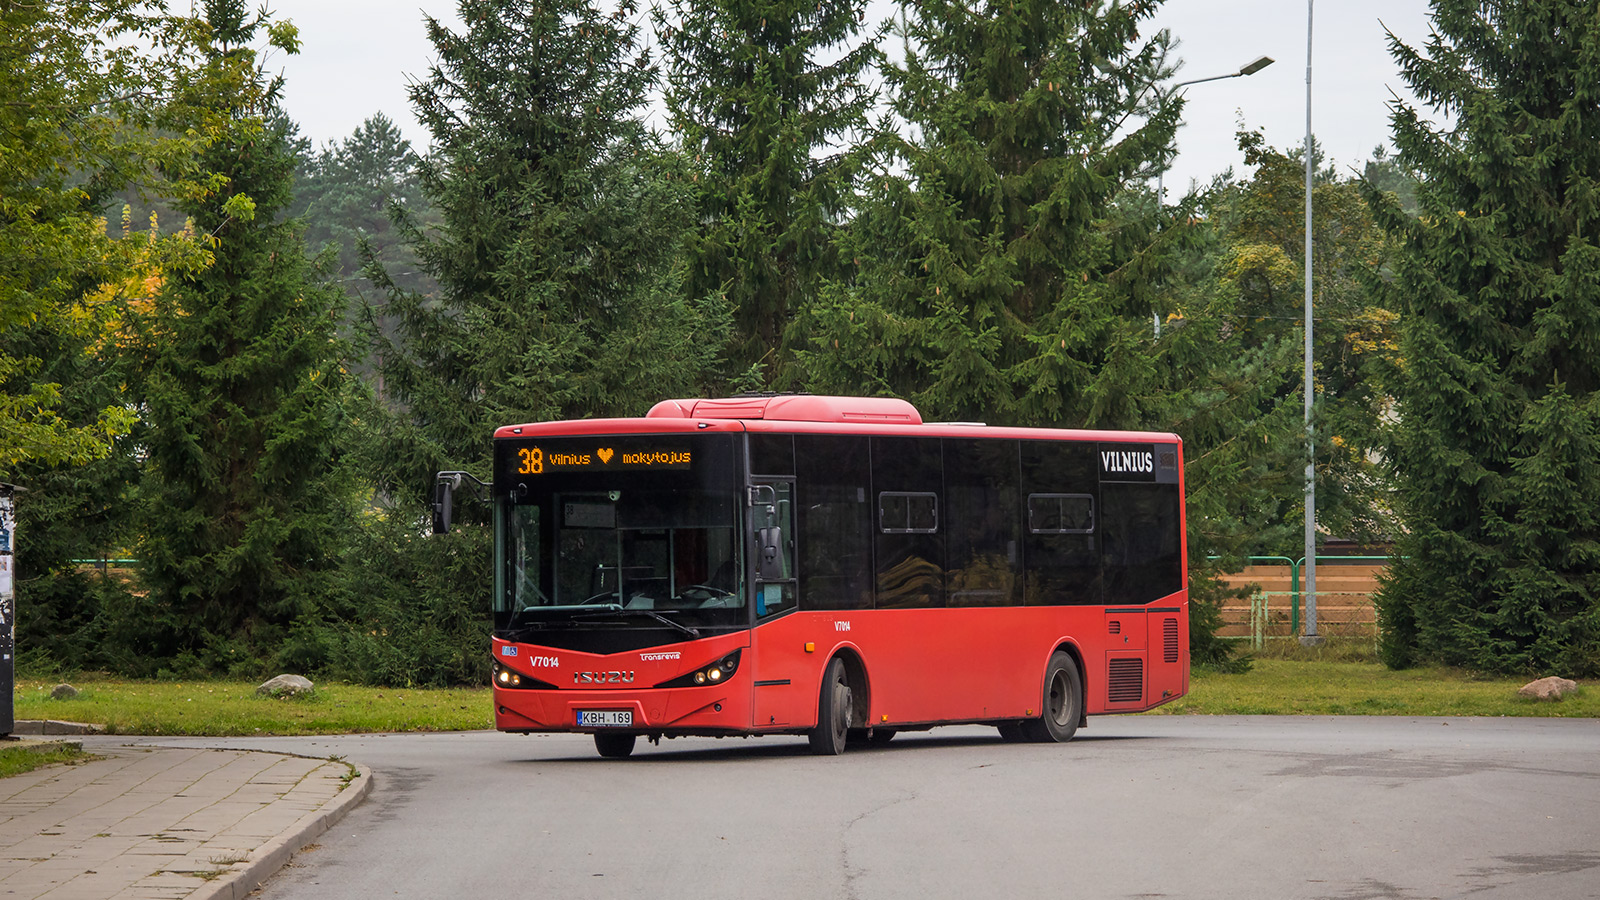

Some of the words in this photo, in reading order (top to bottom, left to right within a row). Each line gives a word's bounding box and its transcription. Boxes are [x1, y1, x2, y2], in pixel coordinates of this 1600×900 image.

[518, 448, 543, 474] 38
[550, 453, 591, 465] Vilnius
[622, 452, 691, 464] mokytojus
[1101, 451, 1153, 472] VILNIUS
[834, 620, 851, 632] V7014
[530, 656, 559, 668] V7014
[574, 670, 634, 684] ISUZU
[583, 712, 605, 723] KBH
[612, 712, 630, 723] 169
